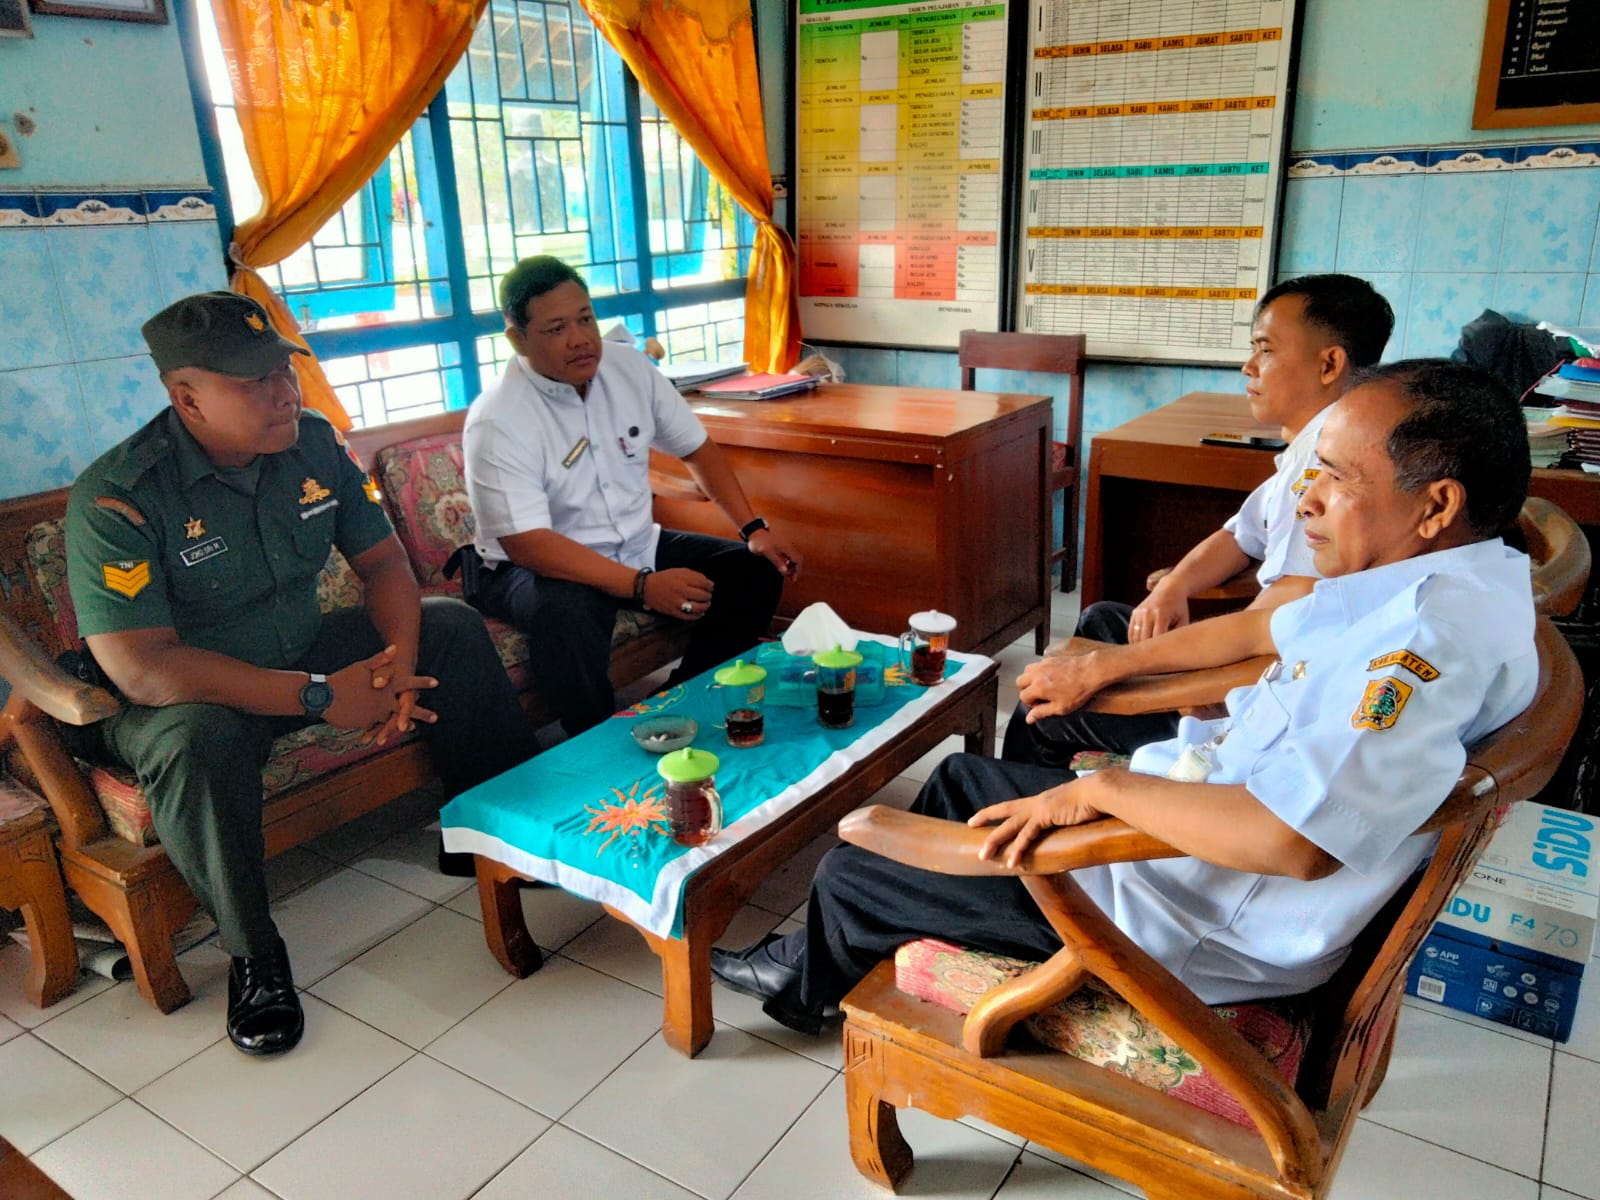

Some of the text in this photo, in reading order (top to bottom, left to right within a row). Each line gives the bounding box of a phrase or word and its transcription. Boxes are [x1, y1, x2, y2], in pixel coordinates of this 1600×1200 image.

[1072, 46, 1090, 54] SENIN
[1100, 44, 1123, 52] SELASA
[1134, 42, 1152, 50] RABU
[1162, 38, 1184, 48] KAMIS
[1195, 36, 1218, 45] JUMAT
[1230, 32, 1253, 42] SABTU
[1262, 31, 1276, 40] KET
[1158, 104, 1180, 112] KAMIS
[1190, 102, 1213, 110] JUMAT
[1224, 100, 1246, 109] SABTU
[1256, 99, 1270, 108] KET
[1094, 168, 1116, 176] SELASA
[1126, 168, 1143, 176] RABU
[1154, 167, 1174, 175] KAMIS
[1186, 166, 1208, 175] JUMAT
[1219, 166, 1241, 174] SABTU
[118, 560, 134, 569] TNI
[1474, 872, 1507, 885] ONE
[1510, 913, 1536, 930] F4
[1544, 921, 1578, 948] 70
